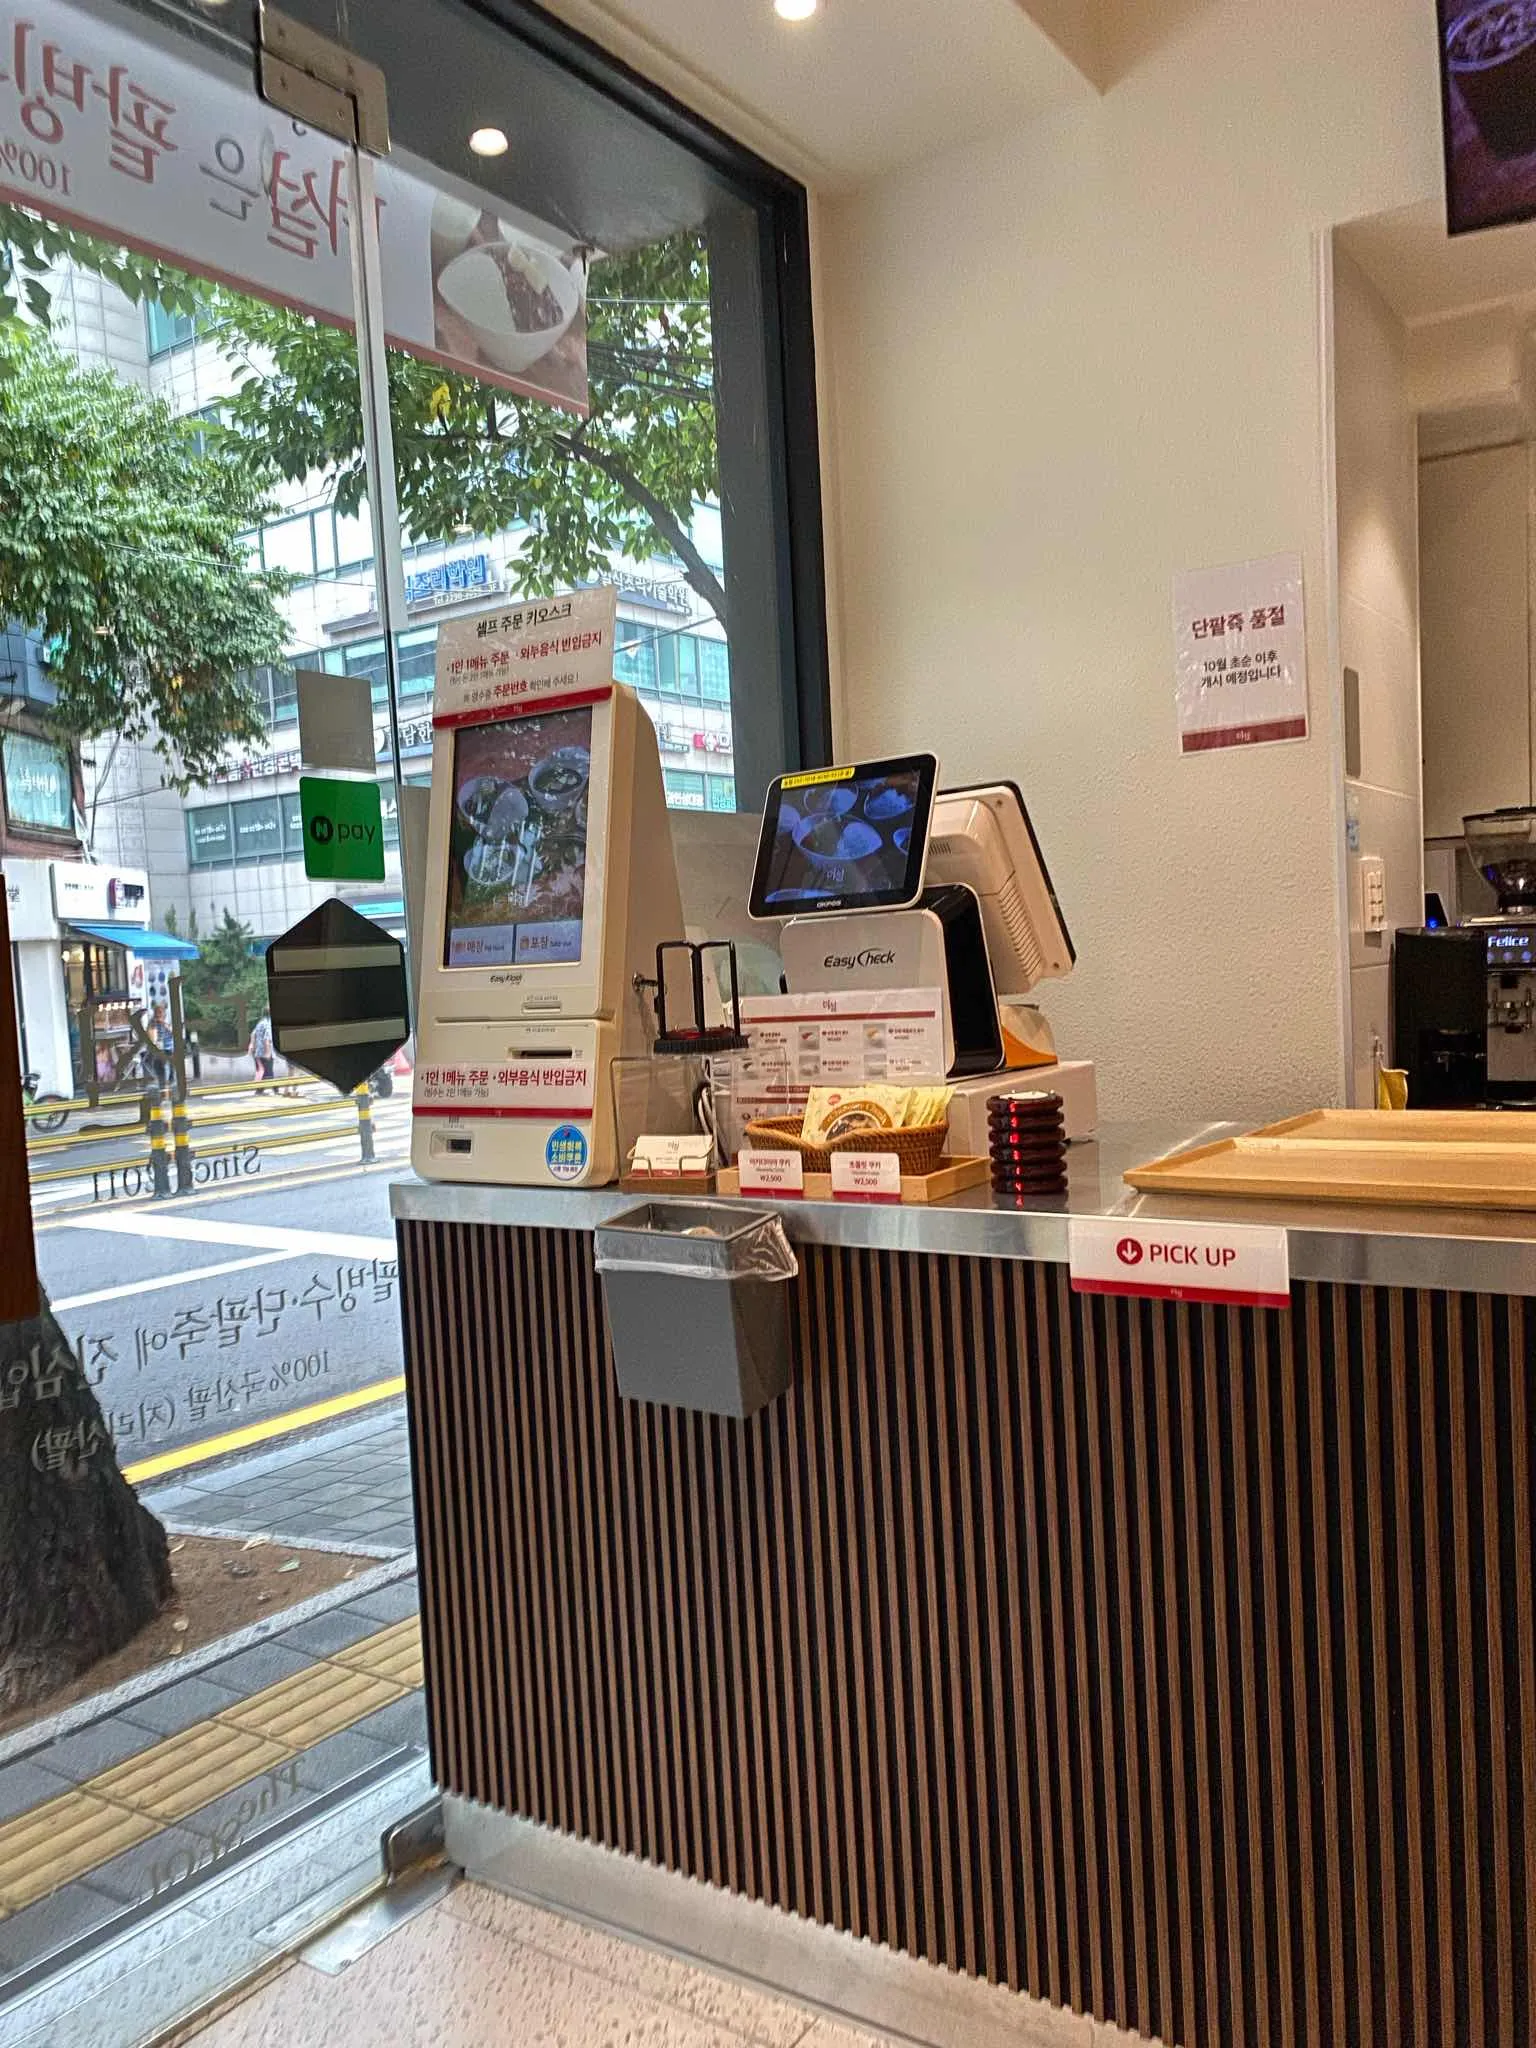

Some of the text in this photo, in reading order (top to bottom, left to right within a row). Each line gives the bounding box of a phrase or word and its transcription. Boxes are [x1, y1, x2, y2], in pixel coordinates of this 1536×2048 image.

[476, 602, 572, 637] 셀프 주문 키오스크
[1192, 603, 1285, 640] 단팥죽 품절
[491, 651, 510, 667] 주문
[1203, 649, 1279, 673] 10월 초순 이후
[1201, 664, 1282, 689] 개시 예정입니다
[493, 680, 528, 699] 주문번호
[337, 821, 376, 844] pay
[1488, 935, 1529, 948] Felice
[442, 1070, 466, 1087] 1메뉴
[468, 1069, 489, 1087] 주문
[498, 1069, 540, 1087] 외부음식
[543, 1068, 588, 1088] 반입금지
[1149, 1243, 1237, 1268] PICK UP
